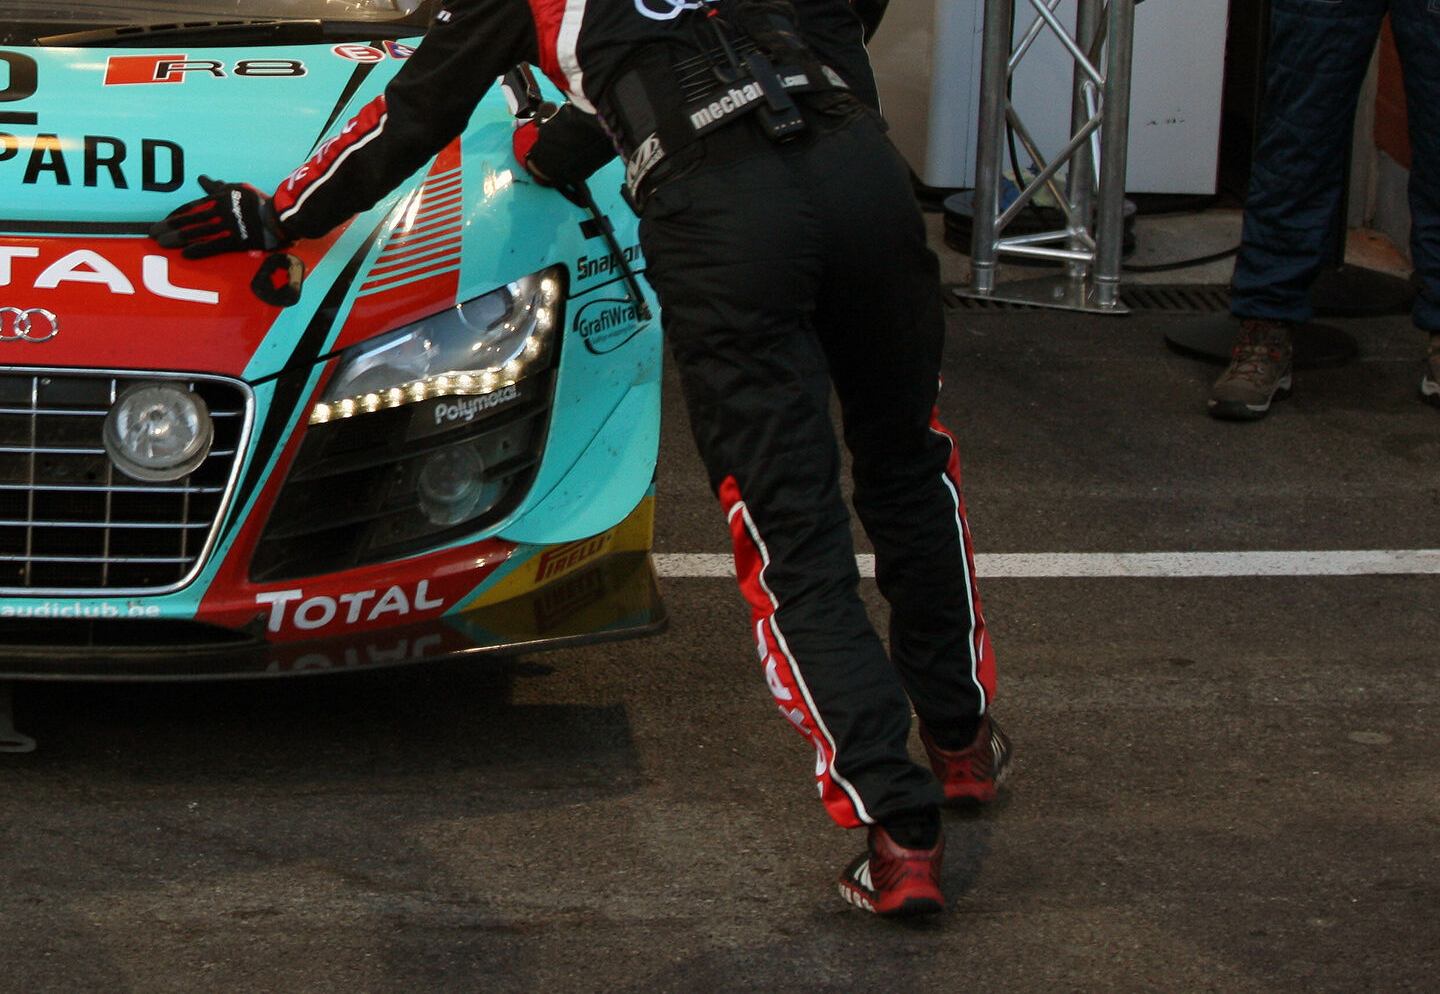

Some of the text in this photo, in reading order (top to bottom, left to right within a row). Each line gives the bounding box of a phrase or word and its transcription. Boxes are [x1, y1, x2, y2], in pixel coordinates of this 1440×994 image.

[155, 58, 308, 79] R8
[579, 305, 641, 338] GrafiWra
[534, 533, 607, 583] PIRELLI
[255, 579, 444, 632] TOTAL
